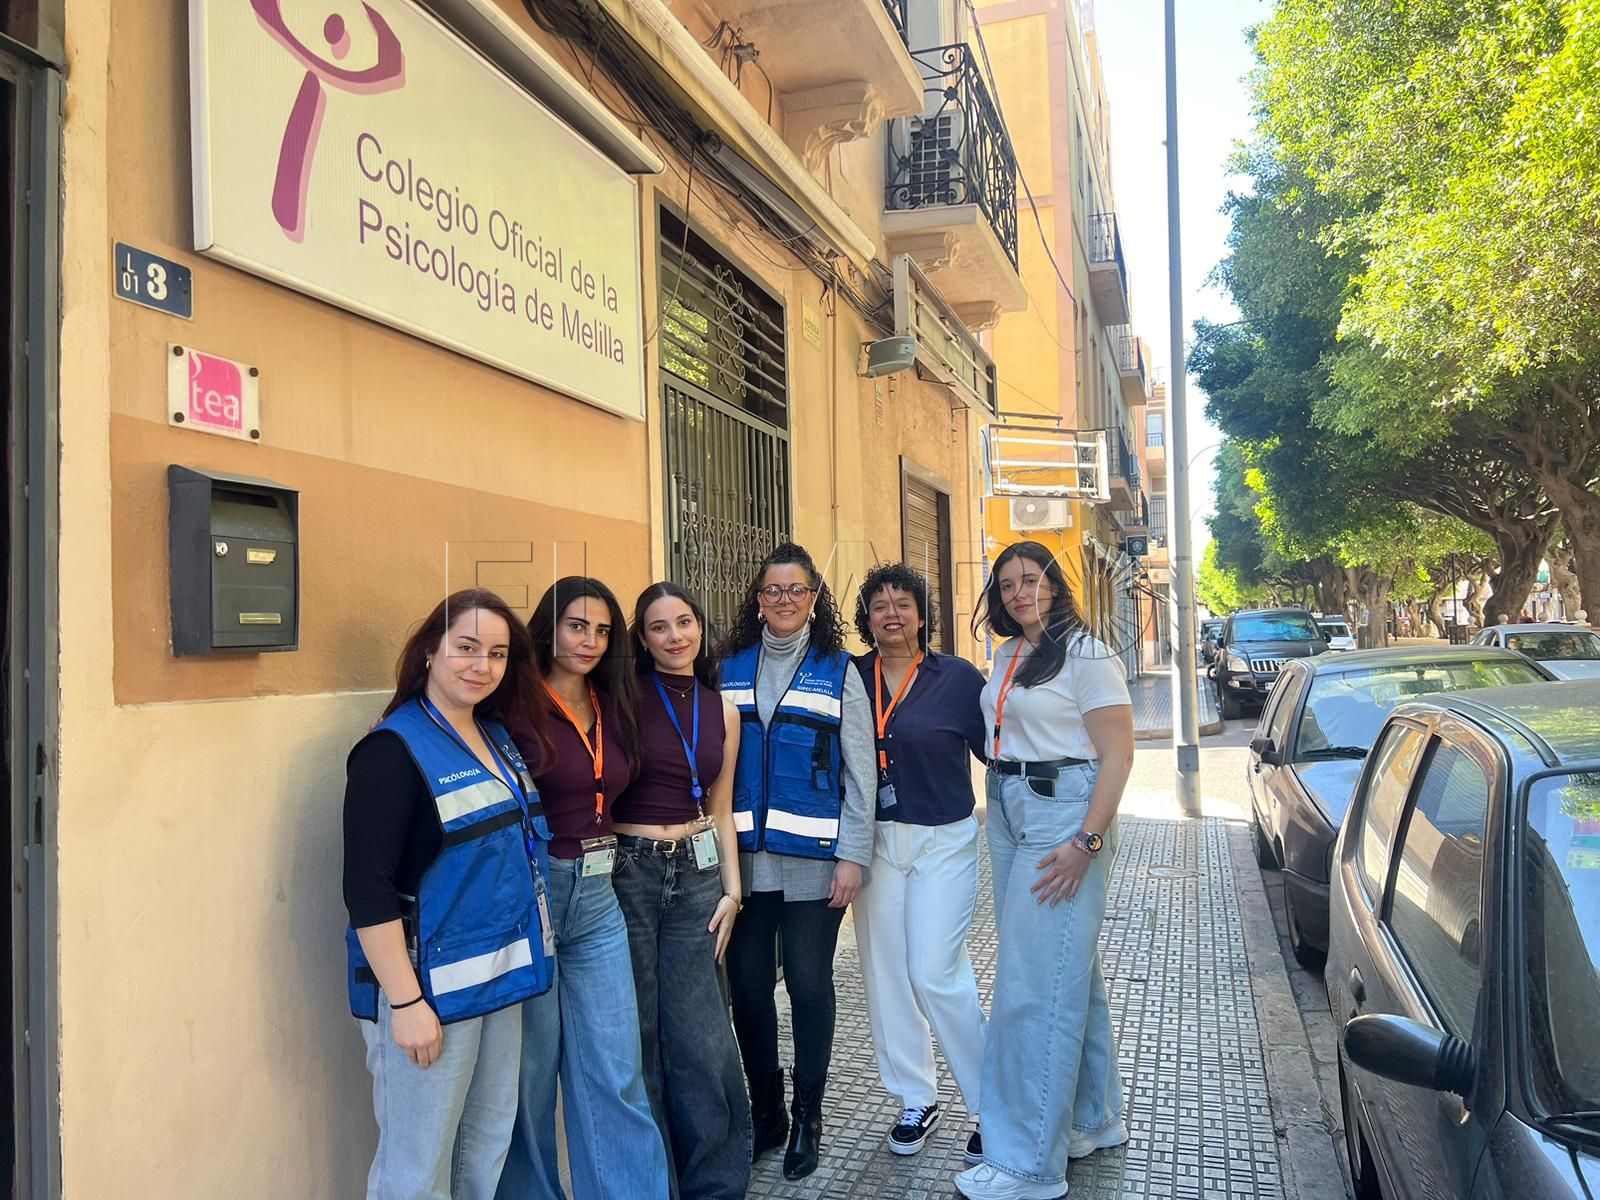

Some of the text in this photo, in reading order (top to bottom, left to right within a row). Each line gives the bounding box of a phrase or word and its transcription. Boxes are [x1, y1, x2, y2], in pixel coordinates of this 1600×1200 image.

[356, 132, 618, 314] Colegio Oficial de la
[122, 271, 139, 294] 01
[146, 262, 168, 300] 3
[359, 197, 624, 365] Psicología de Melilla
[191, 380, 240, 421] tea
